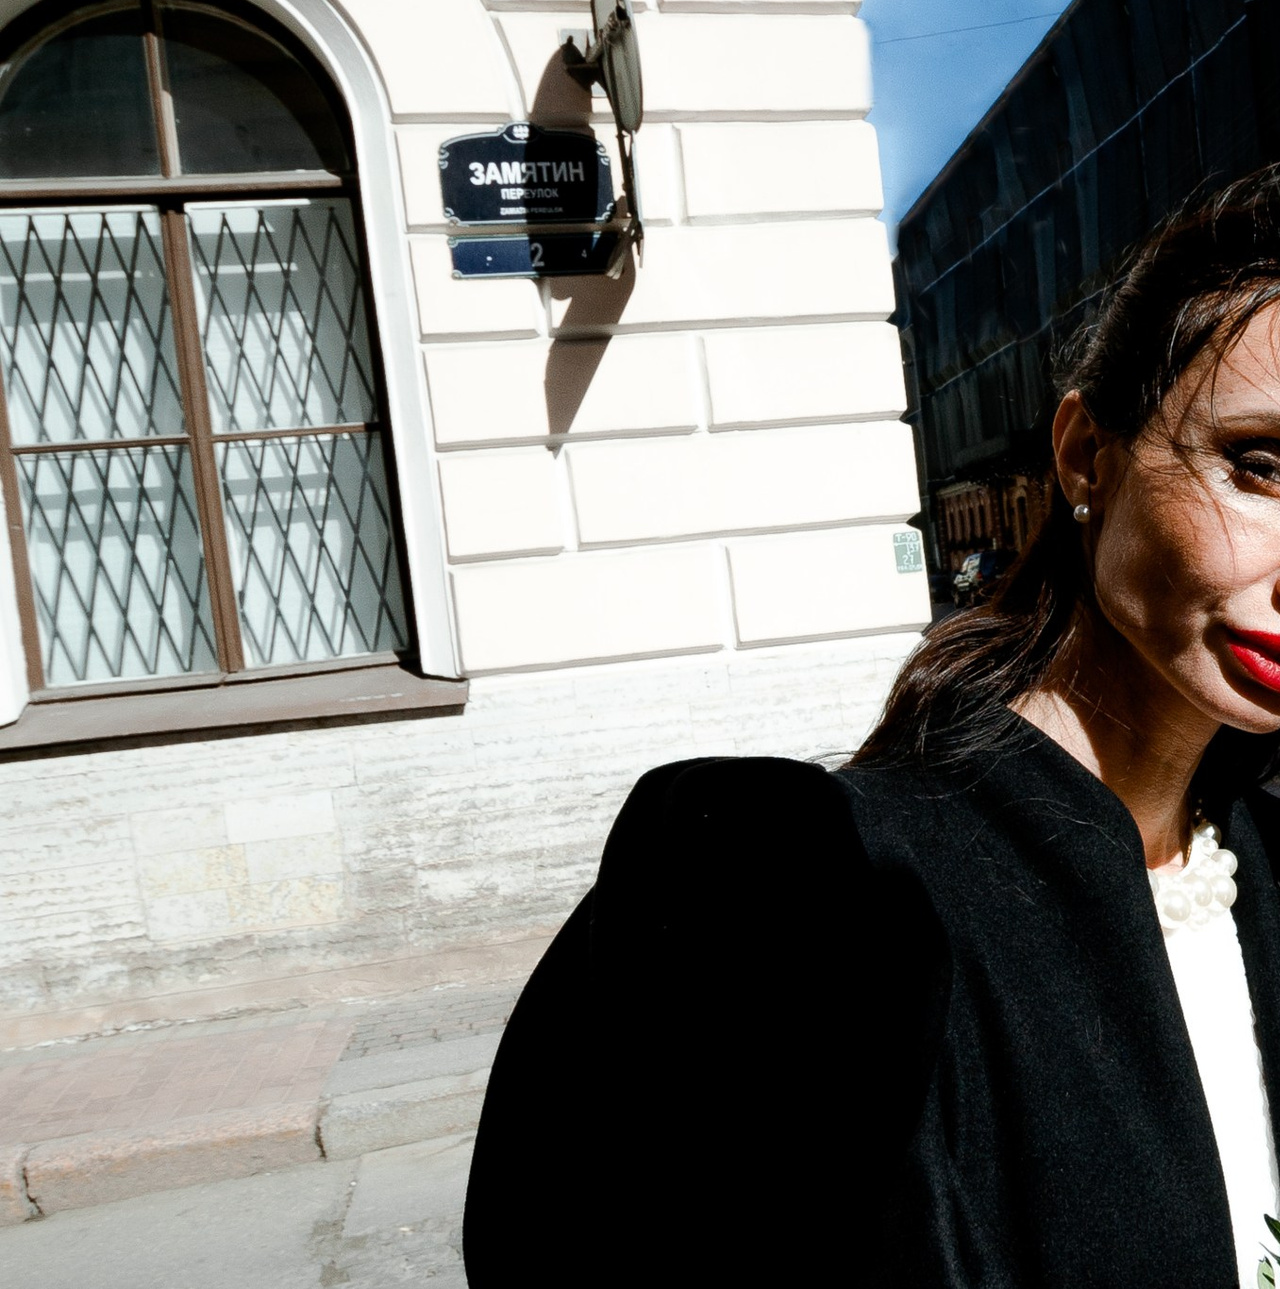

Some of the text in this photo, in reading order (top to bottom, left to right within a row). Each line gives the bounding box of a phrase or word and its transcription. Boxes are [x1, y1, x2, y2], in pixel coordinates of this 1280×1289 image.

[469, 161, 585, 186] ЗАМЯТИН
[500, 187, 559, 200] ПЕРЕУЛОК
[531, 242, 545, 267] 2
